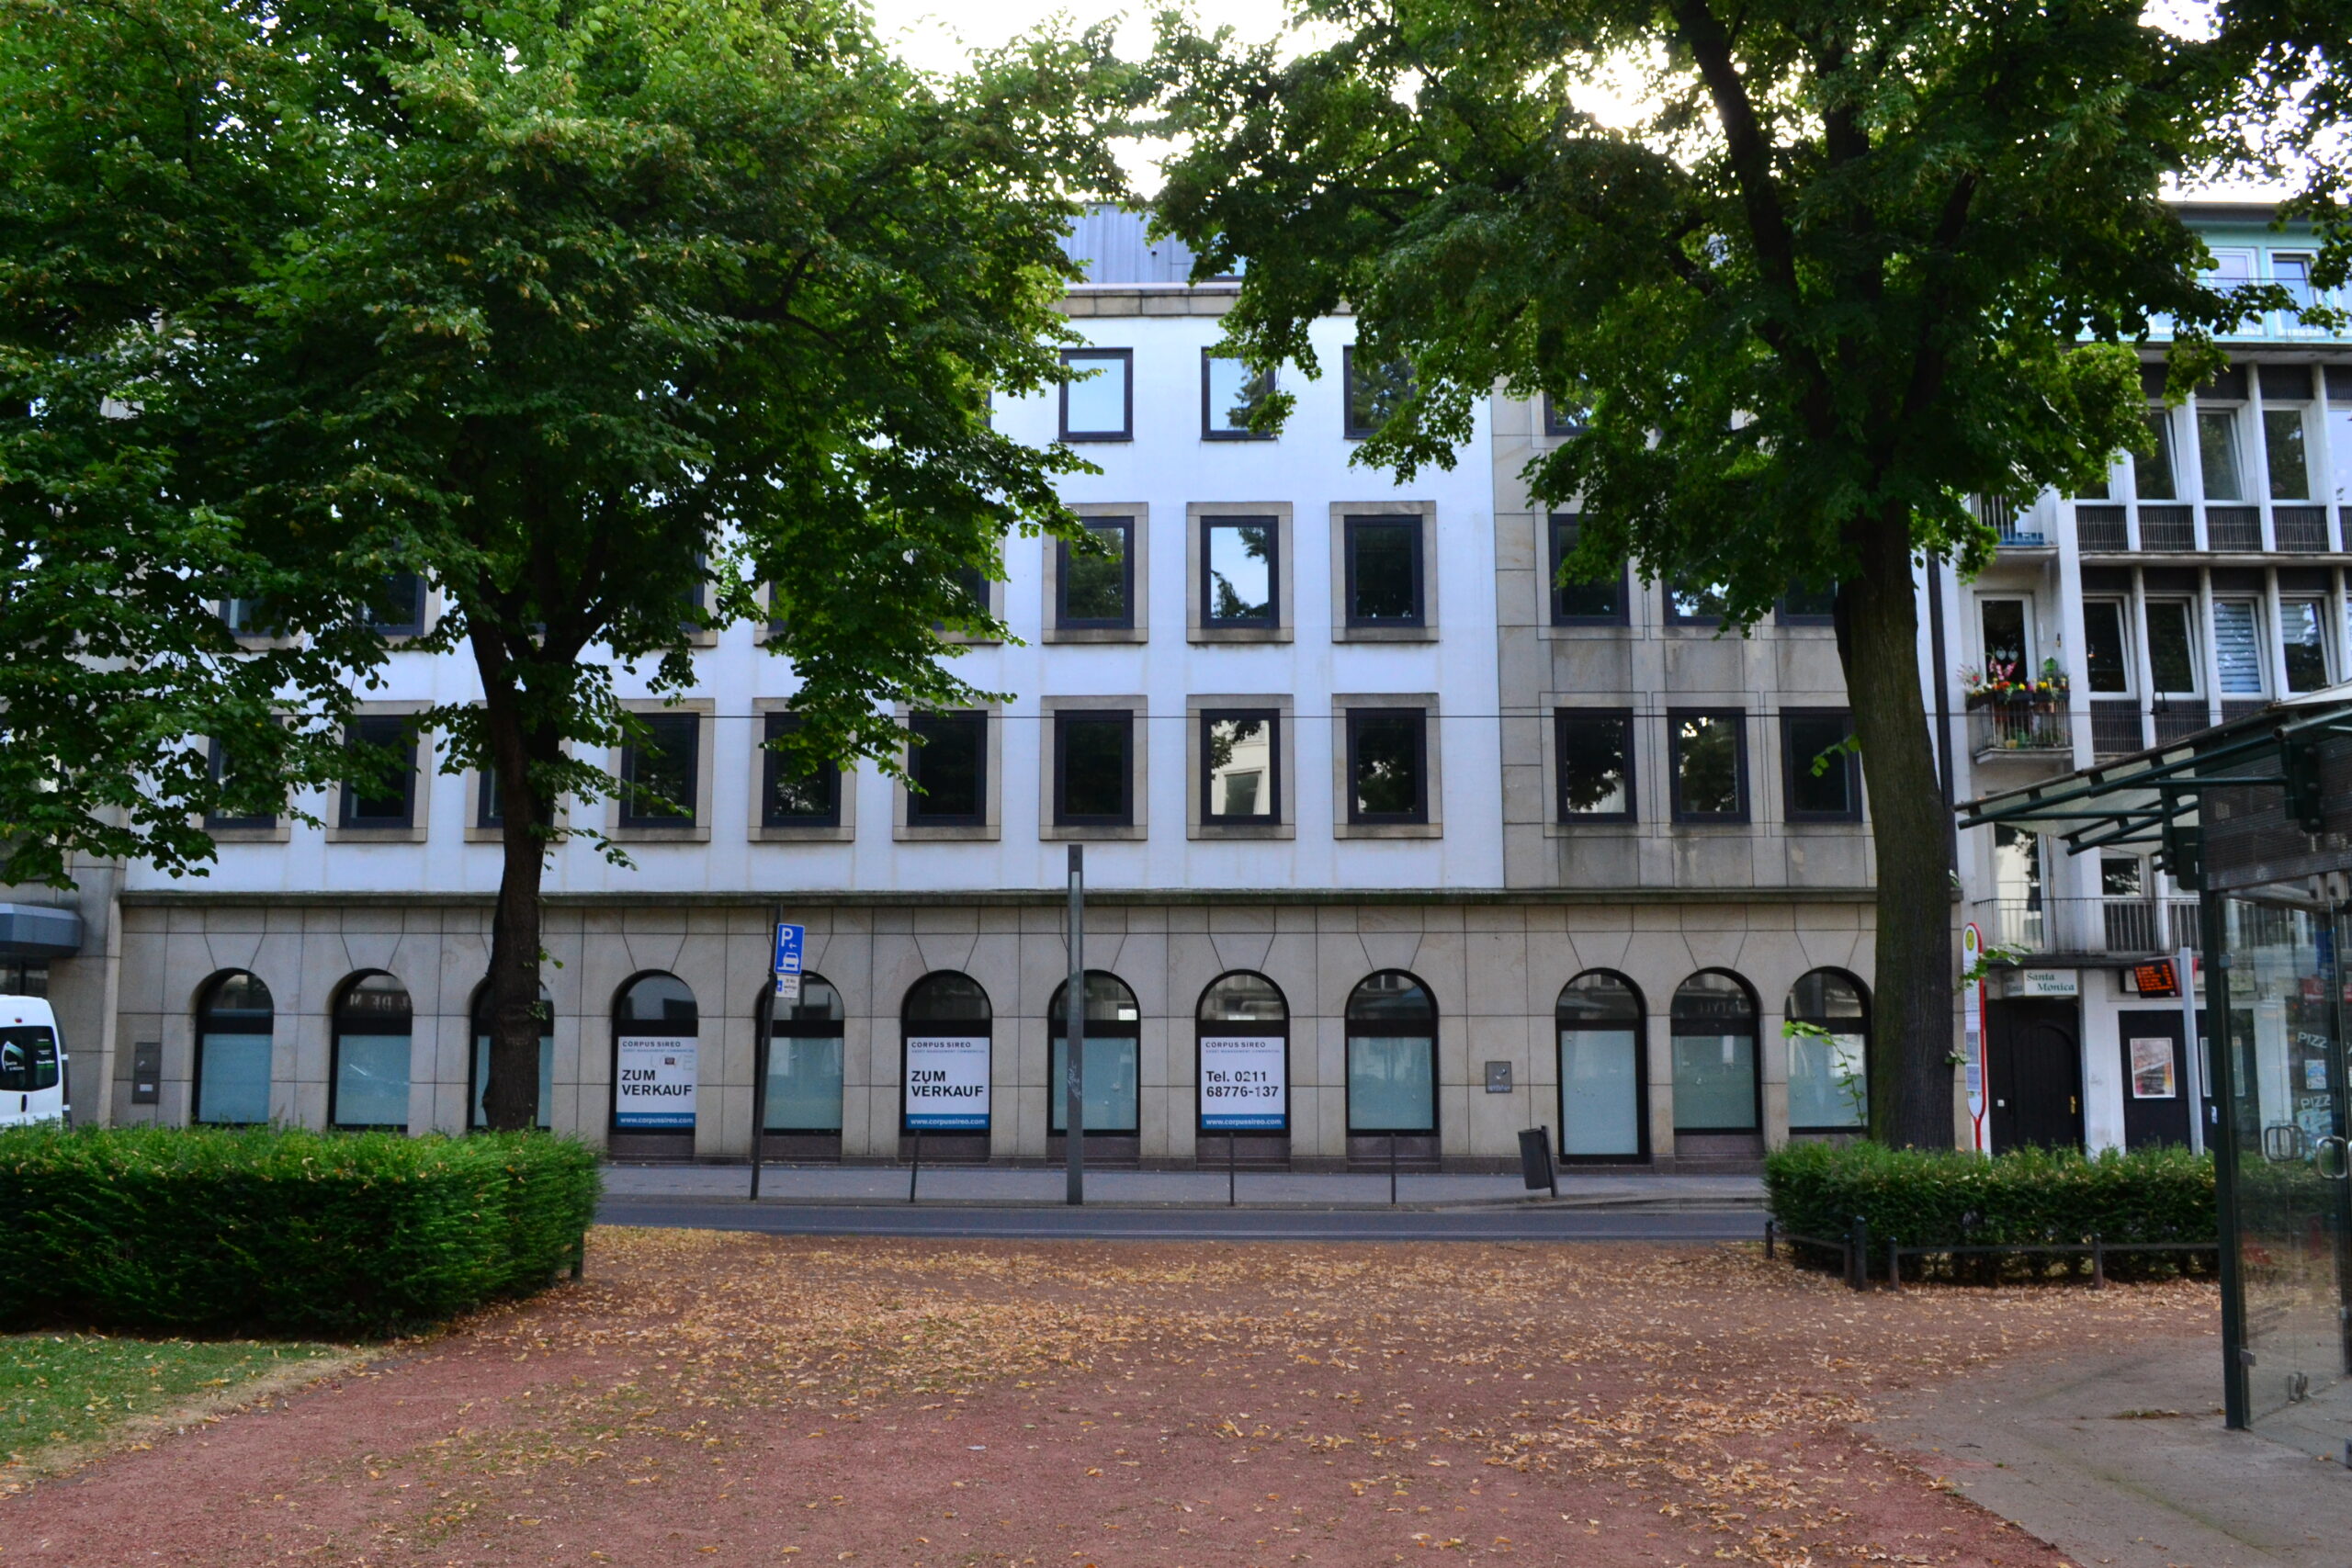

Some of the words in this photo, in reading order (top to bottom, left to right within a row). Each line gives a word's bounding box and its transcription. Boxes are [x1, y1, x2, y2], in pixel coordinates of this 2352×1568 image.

[781, 927, 793, 947] P
[2027, 972, 2055, 982] Santa
[2037, 983, 2075, 991] Monica
[622, 1069, 655, 1081] ZUM
[911, 1070, 945, 1082] ZUM
[1205, 1071, 1230, 1082] Tel.
[1235, 1071, 1266, 1082] 0211
[622, 1084, 693, 1096] VERKAUF
[911, 1085, 984, 1097] VERKAUF
[1206, 1086, 1279, 1098] 68776-137
[910, 1118, 985, 1126] www.corpussireo.com
[1205, 1118, 1282, 1126] www.corpussireo.com
